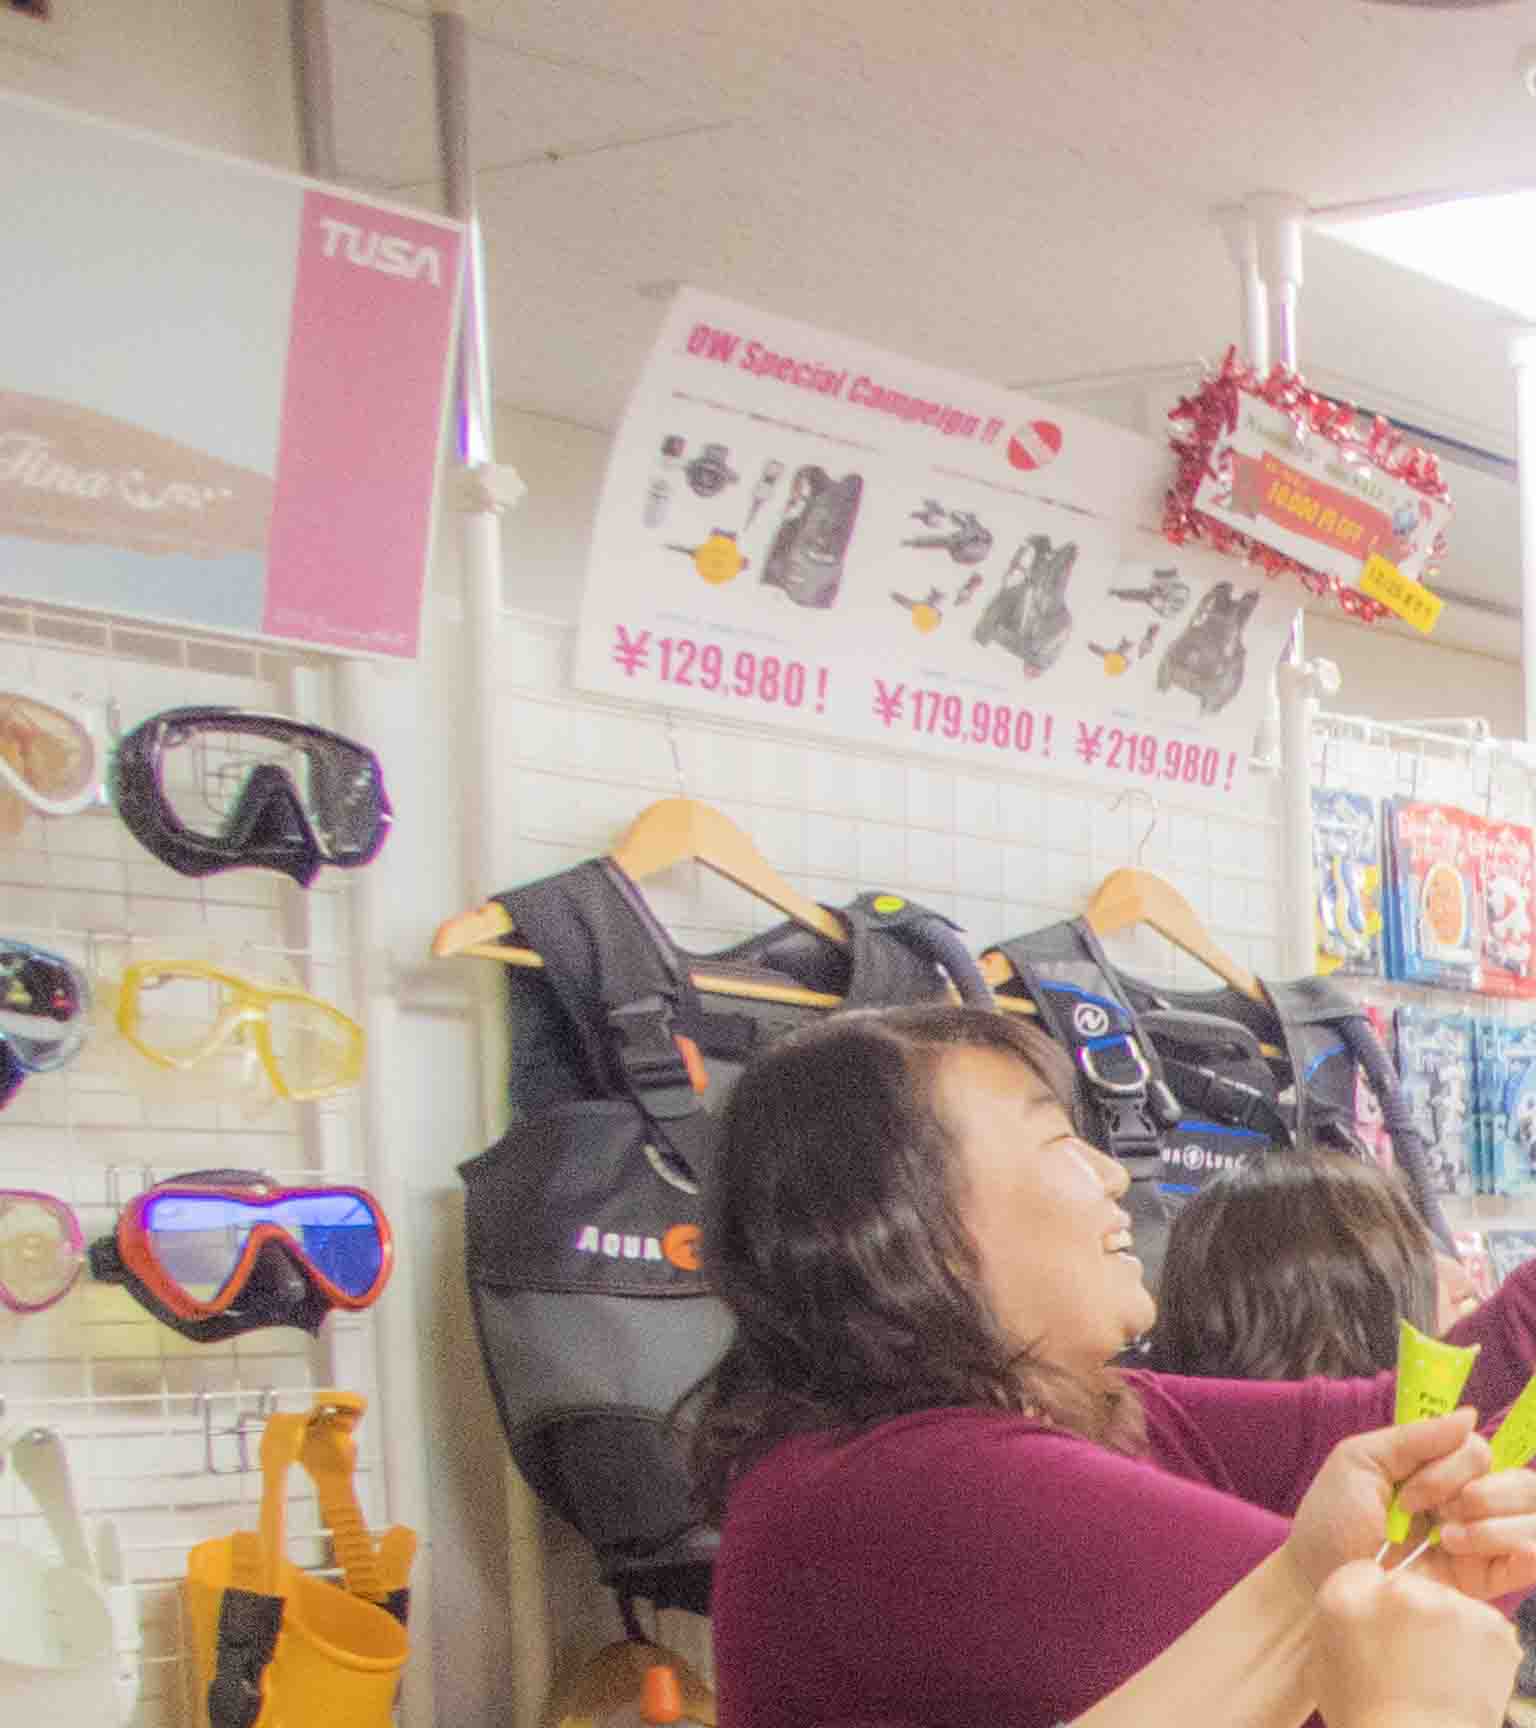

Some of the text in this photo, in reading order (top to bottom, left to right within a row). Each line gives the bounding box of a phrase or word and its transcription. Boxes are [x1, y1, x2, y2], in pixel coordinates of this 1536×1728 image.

[320, 217, 441, 288] TUSA
[686, 321, 740, 363] OW
[739, 340, 848, 399] Special
[846, 375, 982, 438] Campaign
